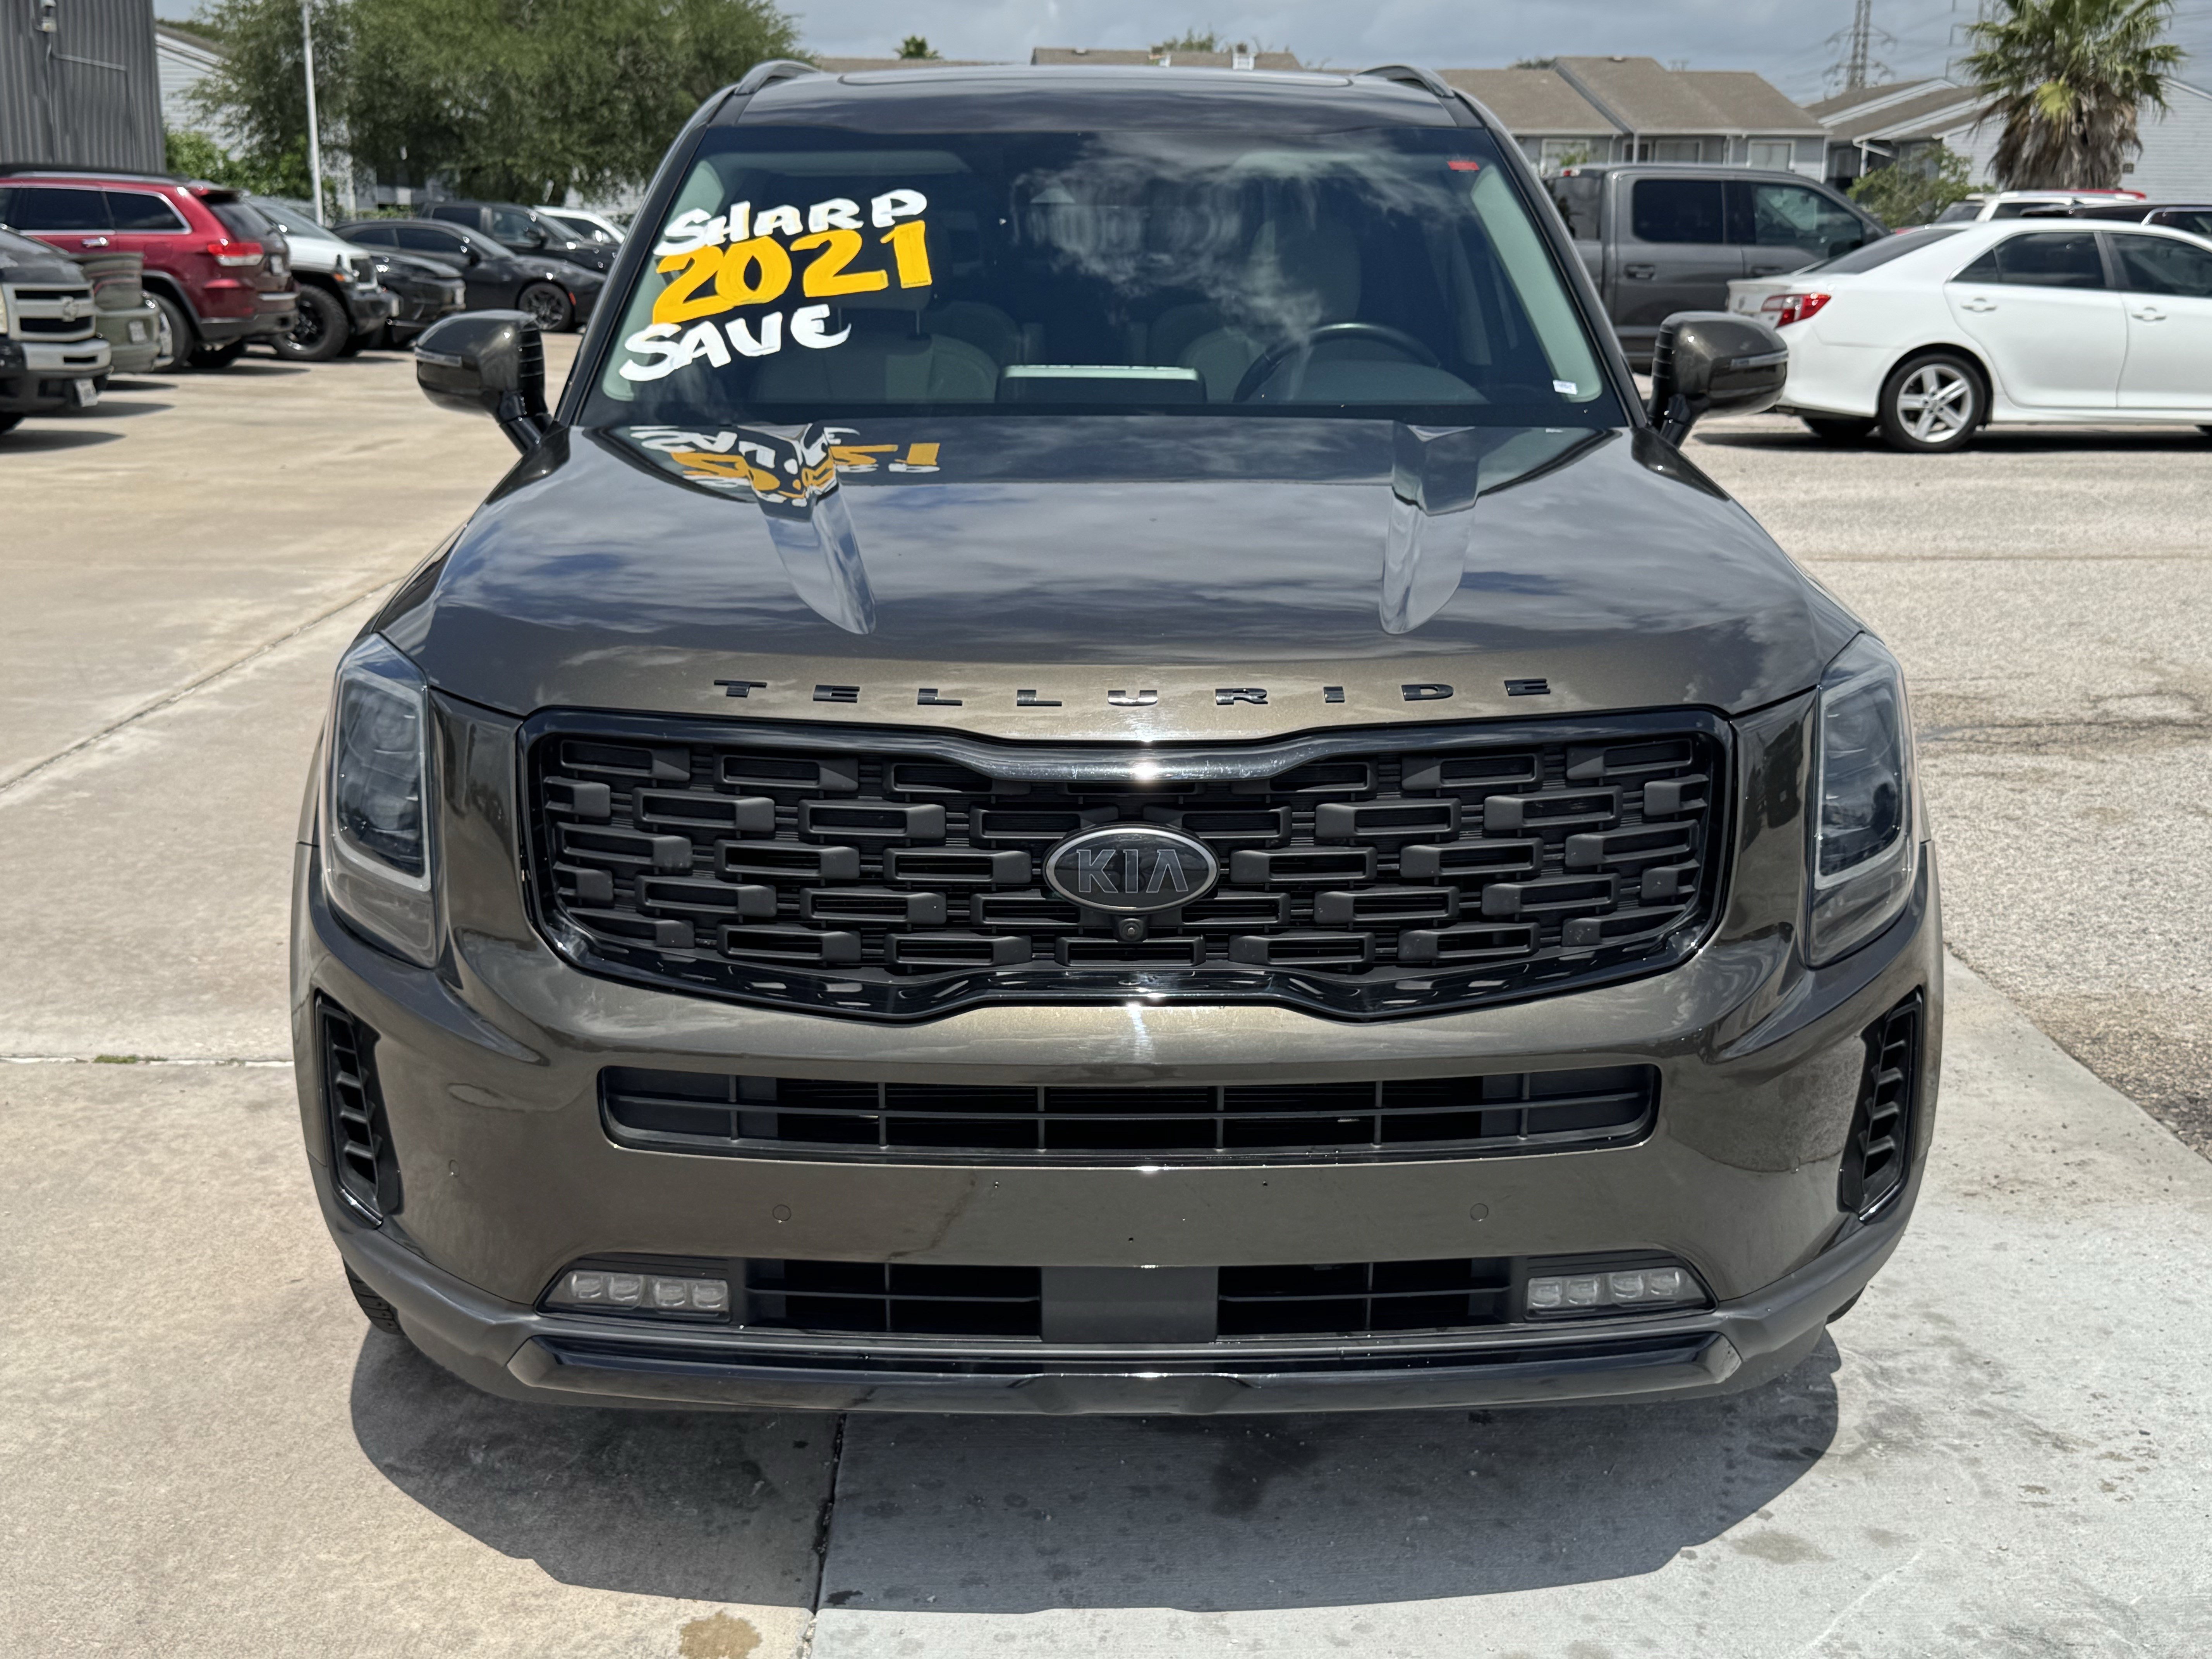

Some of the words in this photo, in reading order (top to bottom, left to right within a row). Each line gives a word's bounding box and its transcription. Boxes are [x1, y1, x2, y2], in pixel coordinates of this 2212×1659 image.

[653, 189, 927, 256] SHARP
[653, 220, 932, 324] 2021
[620, 304, 851, 381] SAVE
[713, 678, 1551, 707] TELLURIDE
[1076, 849, 1189, 893] KIA
